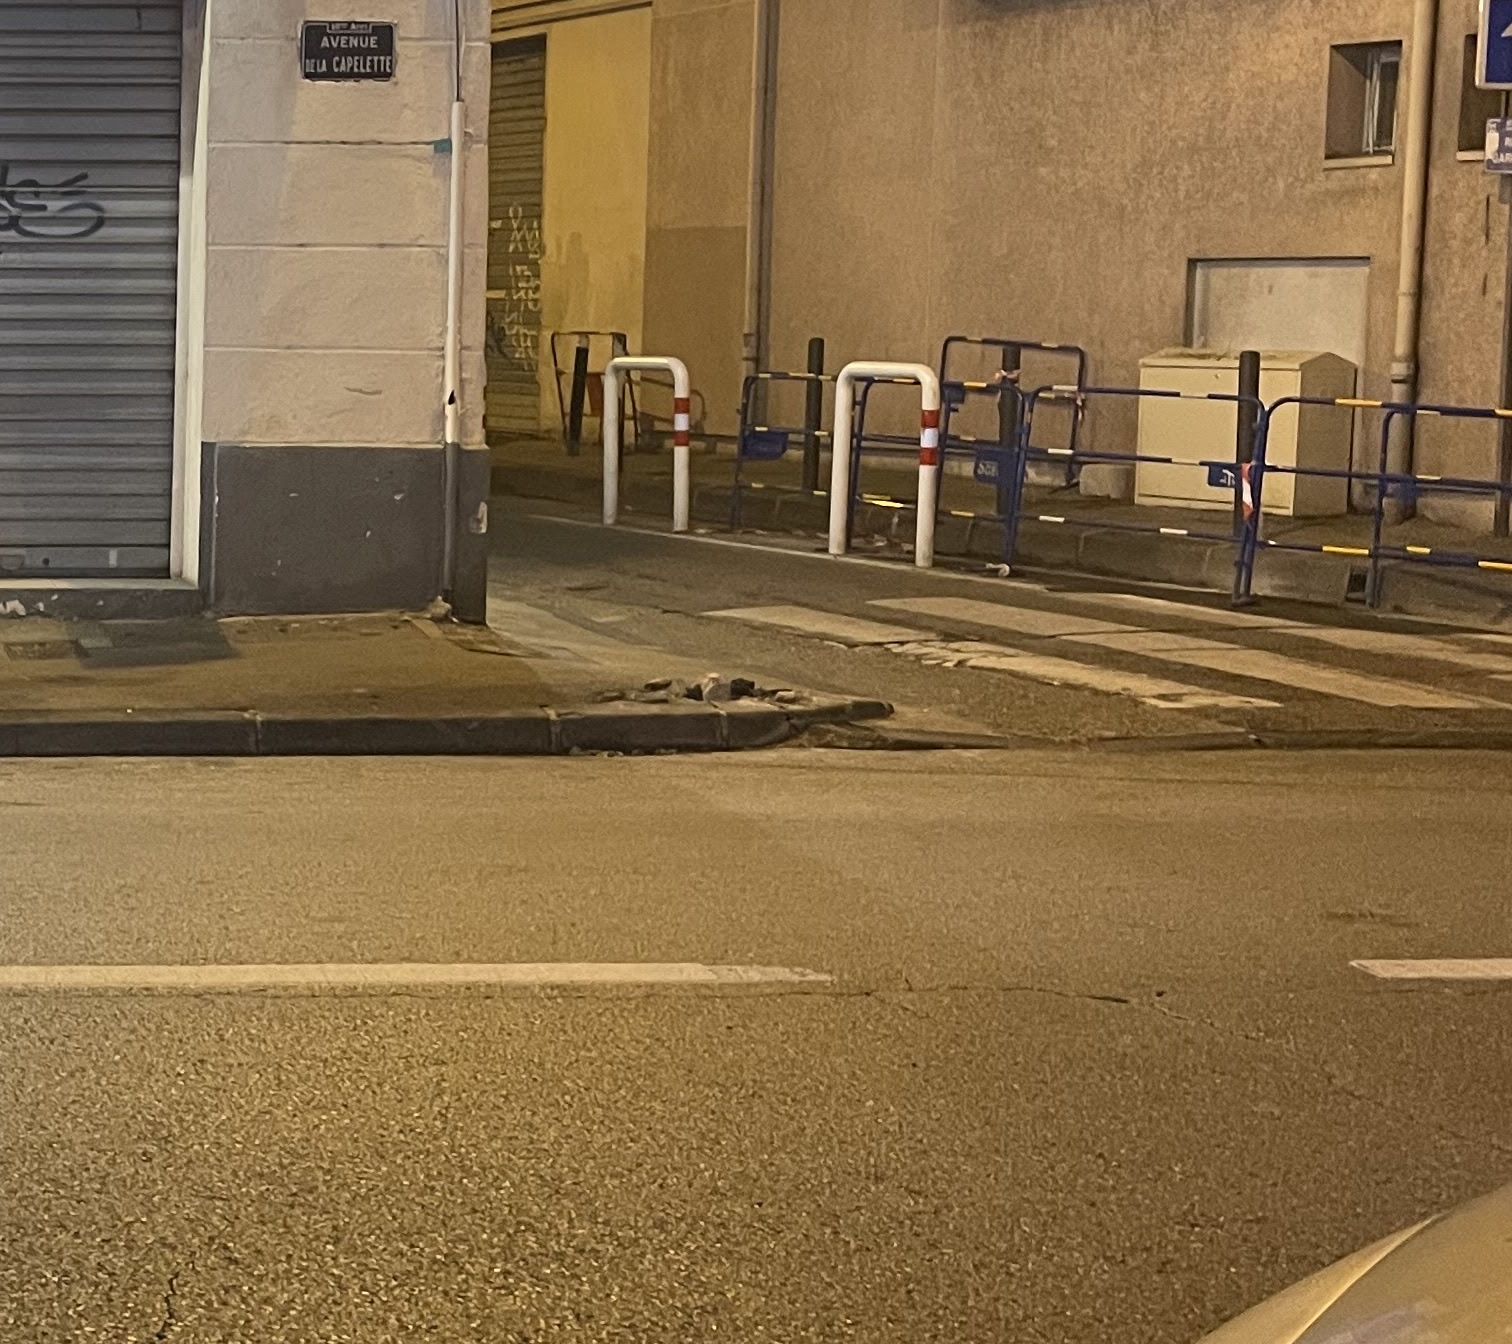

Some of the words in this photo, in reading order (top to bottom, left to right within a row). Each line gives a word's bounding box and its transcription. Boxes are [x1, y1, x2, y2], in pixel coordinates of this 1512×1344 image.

[320, 36, 379, 48] AVENUE
[305, 58, 316, 72] DE
[316, 58, 328, 72] LA
[332, 55, 392, 73] CAPELETTE
